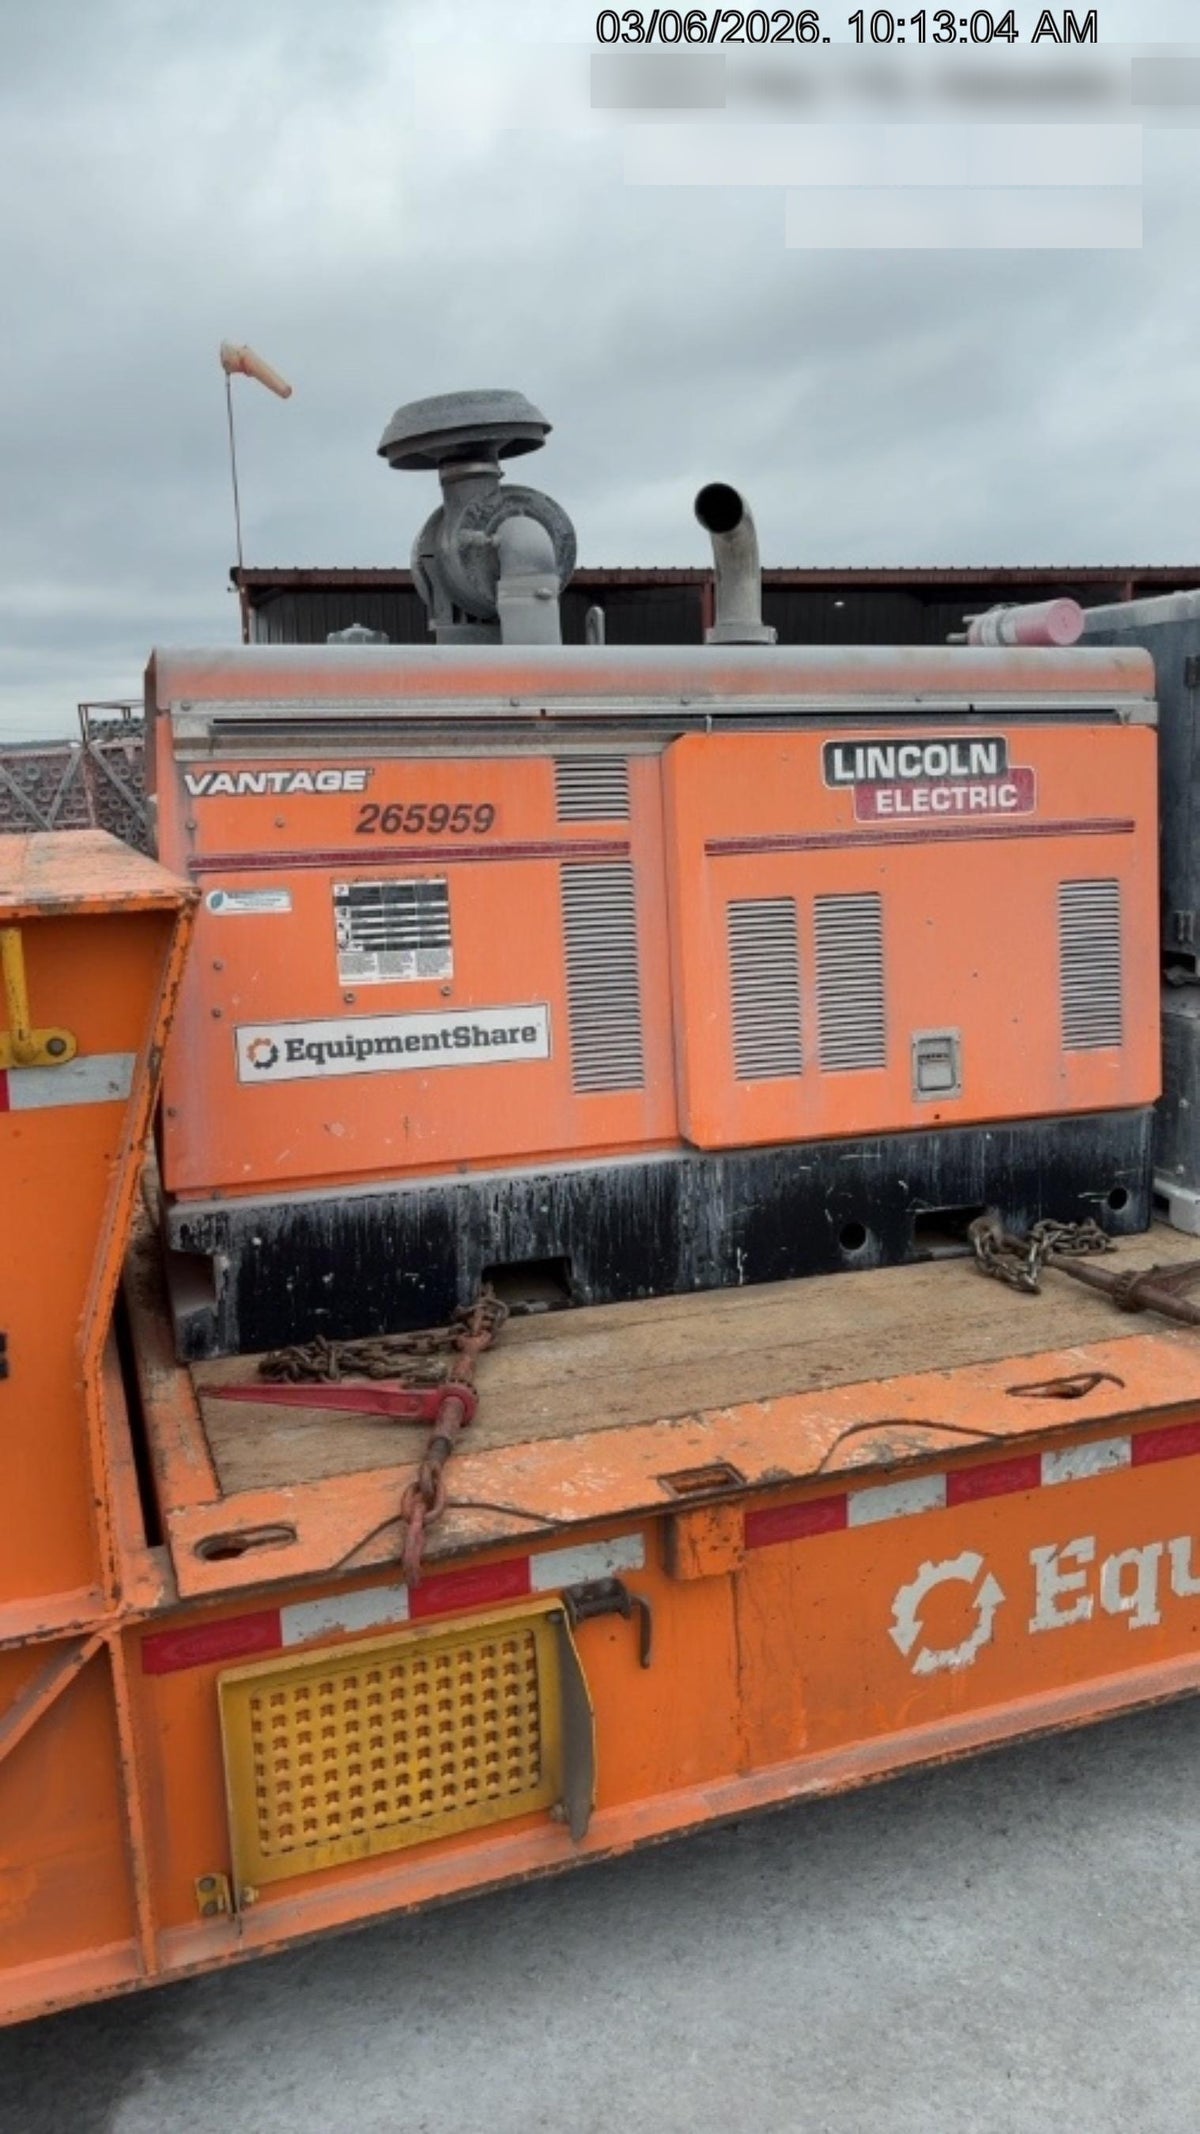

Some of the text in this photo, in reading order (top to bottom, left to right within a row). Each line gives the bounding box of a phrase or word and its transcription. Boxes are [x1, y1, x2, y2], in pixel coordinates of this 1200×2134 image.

[833, 743, 998, 780] LINCOLN
[184, 769, 367, 796] VANTAGE
[876, 784, 1018, 814] ELECTRIC
[355, 803, 496, 833] 265959
[284, 1025, 538, 1064] EquipmentShare
